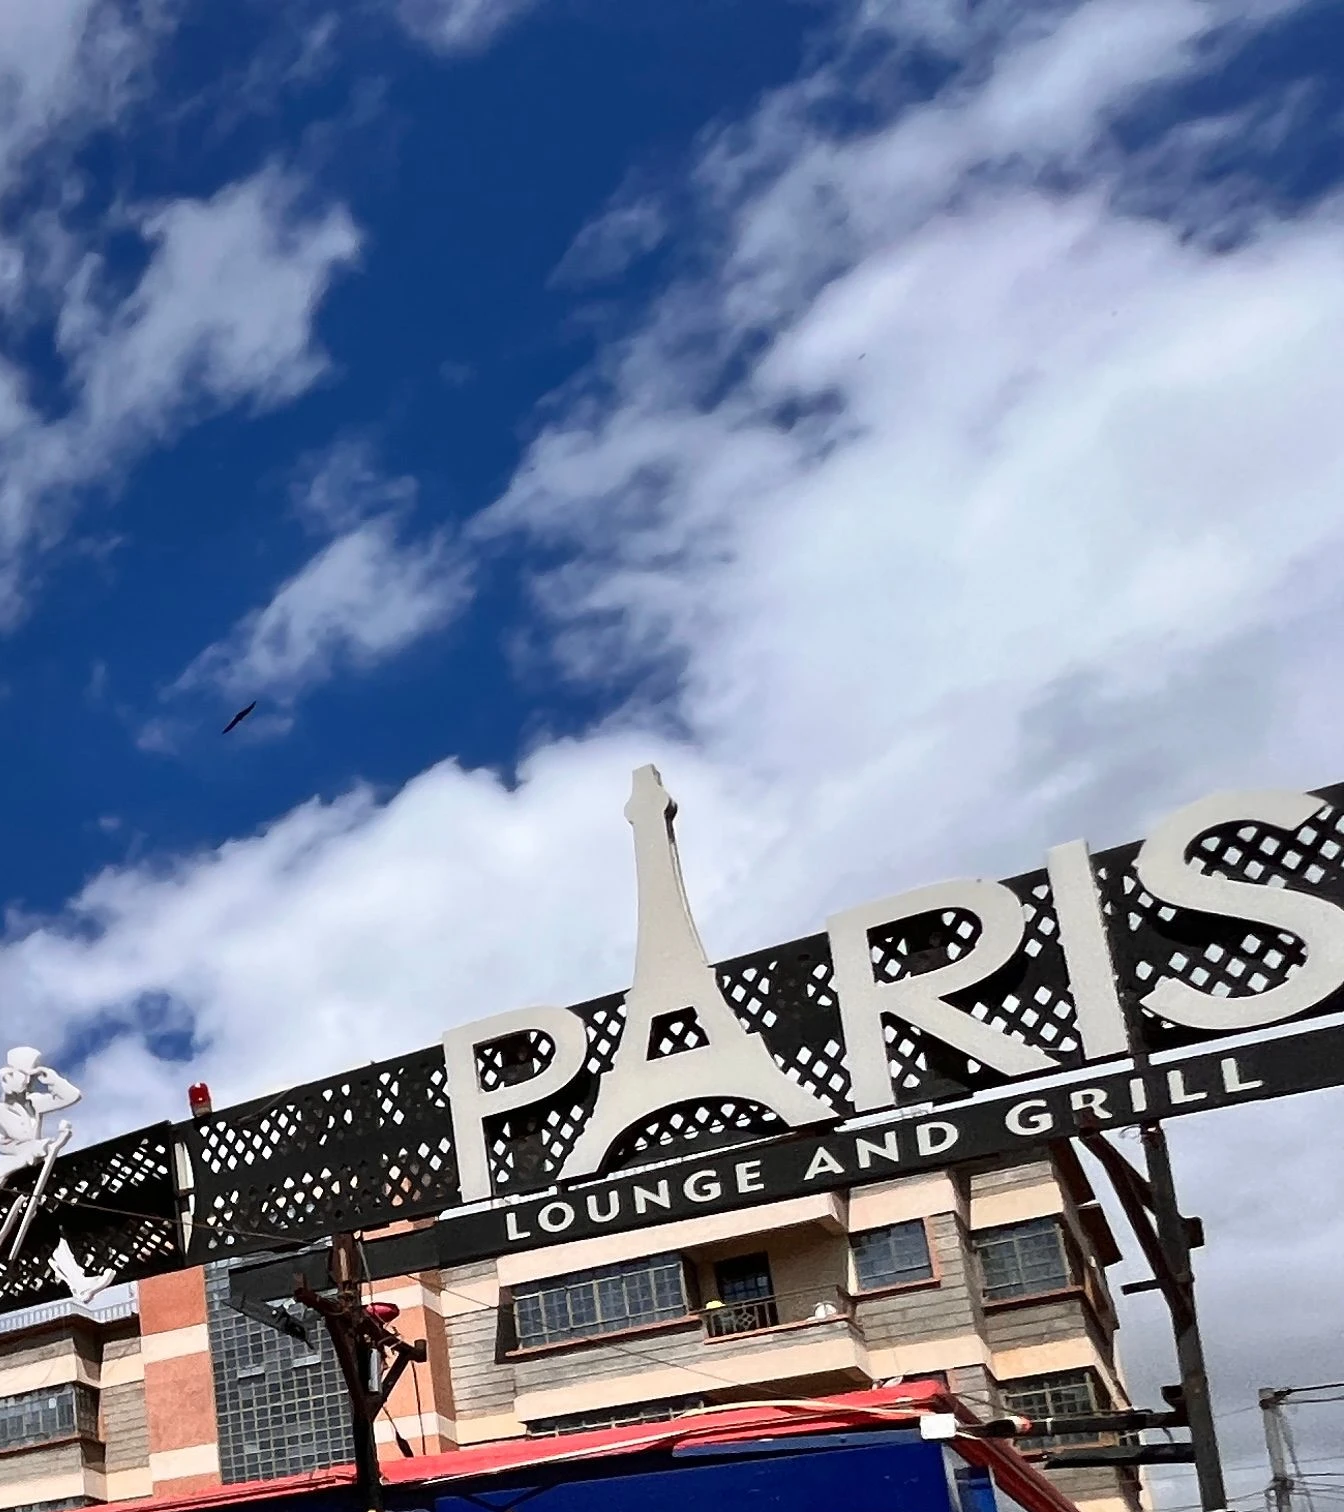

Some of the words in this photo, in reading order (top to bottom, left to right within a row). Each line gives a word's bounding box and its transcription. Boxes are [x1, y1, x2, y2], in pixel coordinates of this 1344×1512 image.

[442, 763, 1344, 1204] PARIS
[505, 1160, 766, 1241] LOUNGE
[804, 1119, 959, 1180] AND
[1004, 1057, 1264, 1137] GRILL
